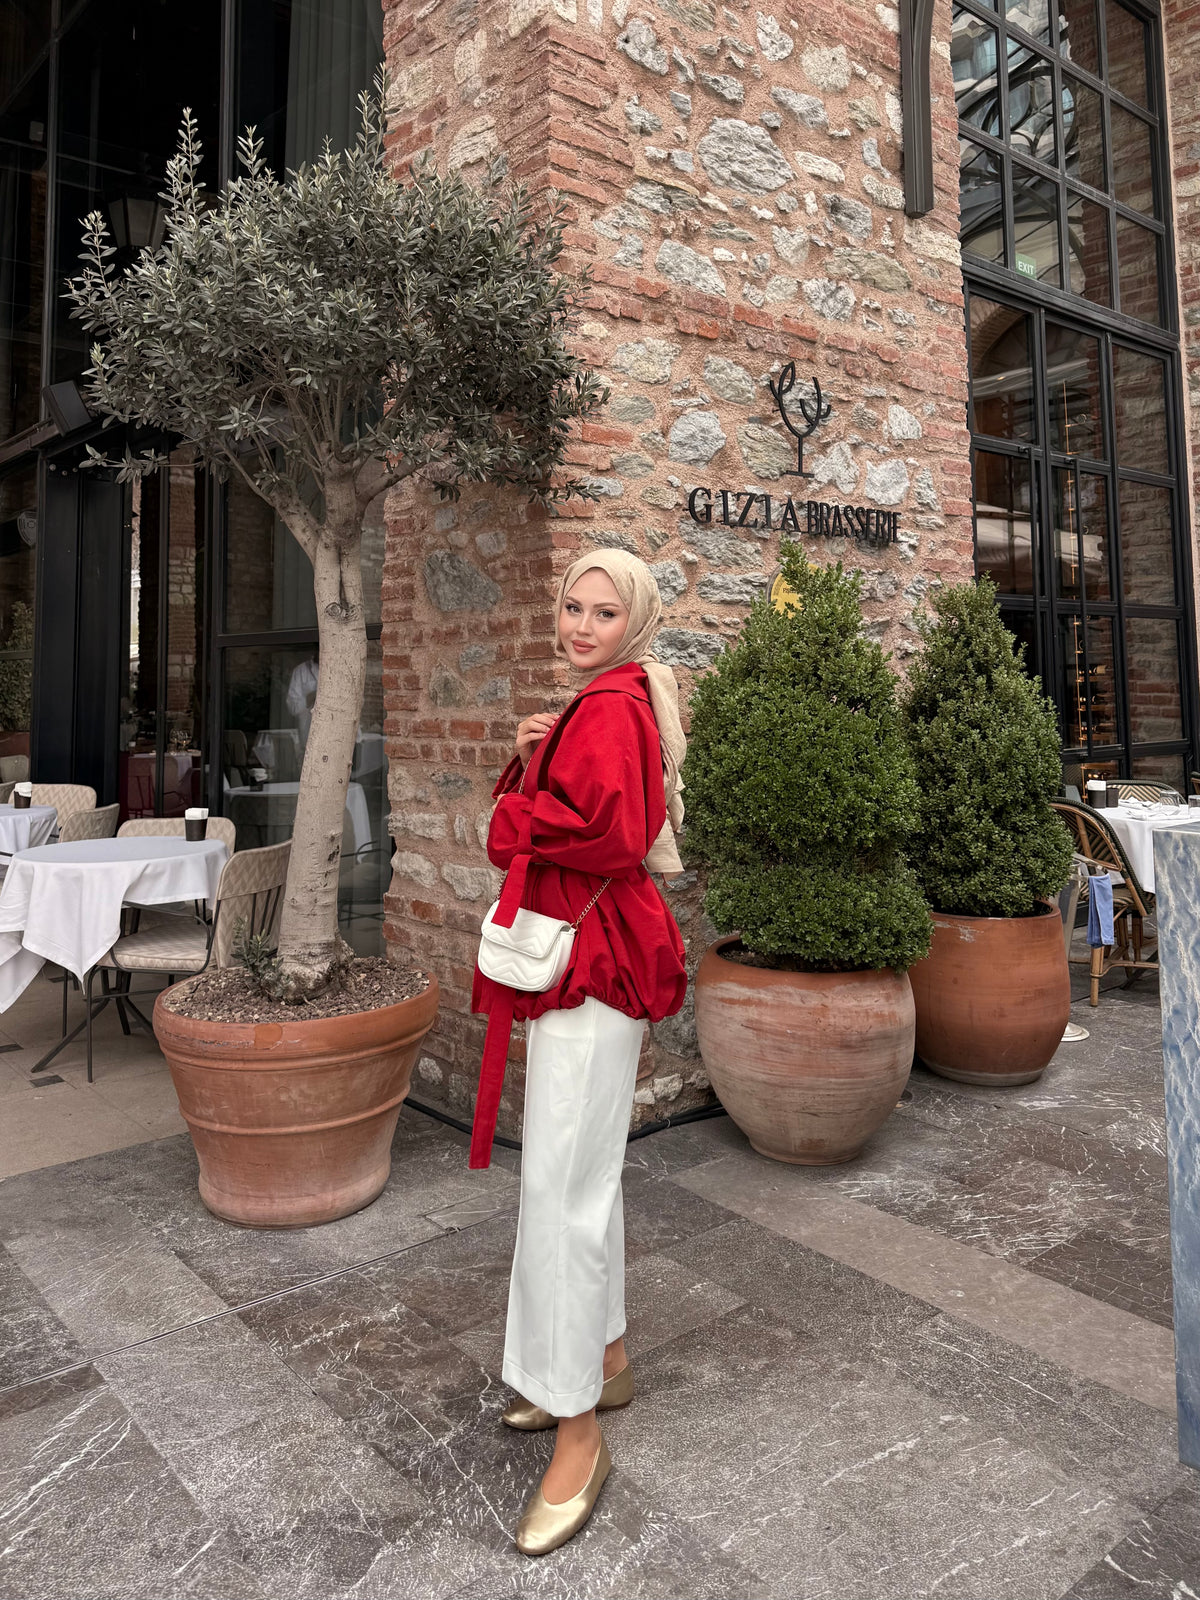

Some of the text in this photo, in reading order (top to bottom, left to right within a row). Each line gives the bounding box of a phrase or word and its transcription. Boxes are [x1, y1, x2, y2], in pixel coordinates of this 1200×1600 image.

[1018, 261, 1034, 275] EXIT
[688, 487, 902, 543] GIZIA BRASSERIE
